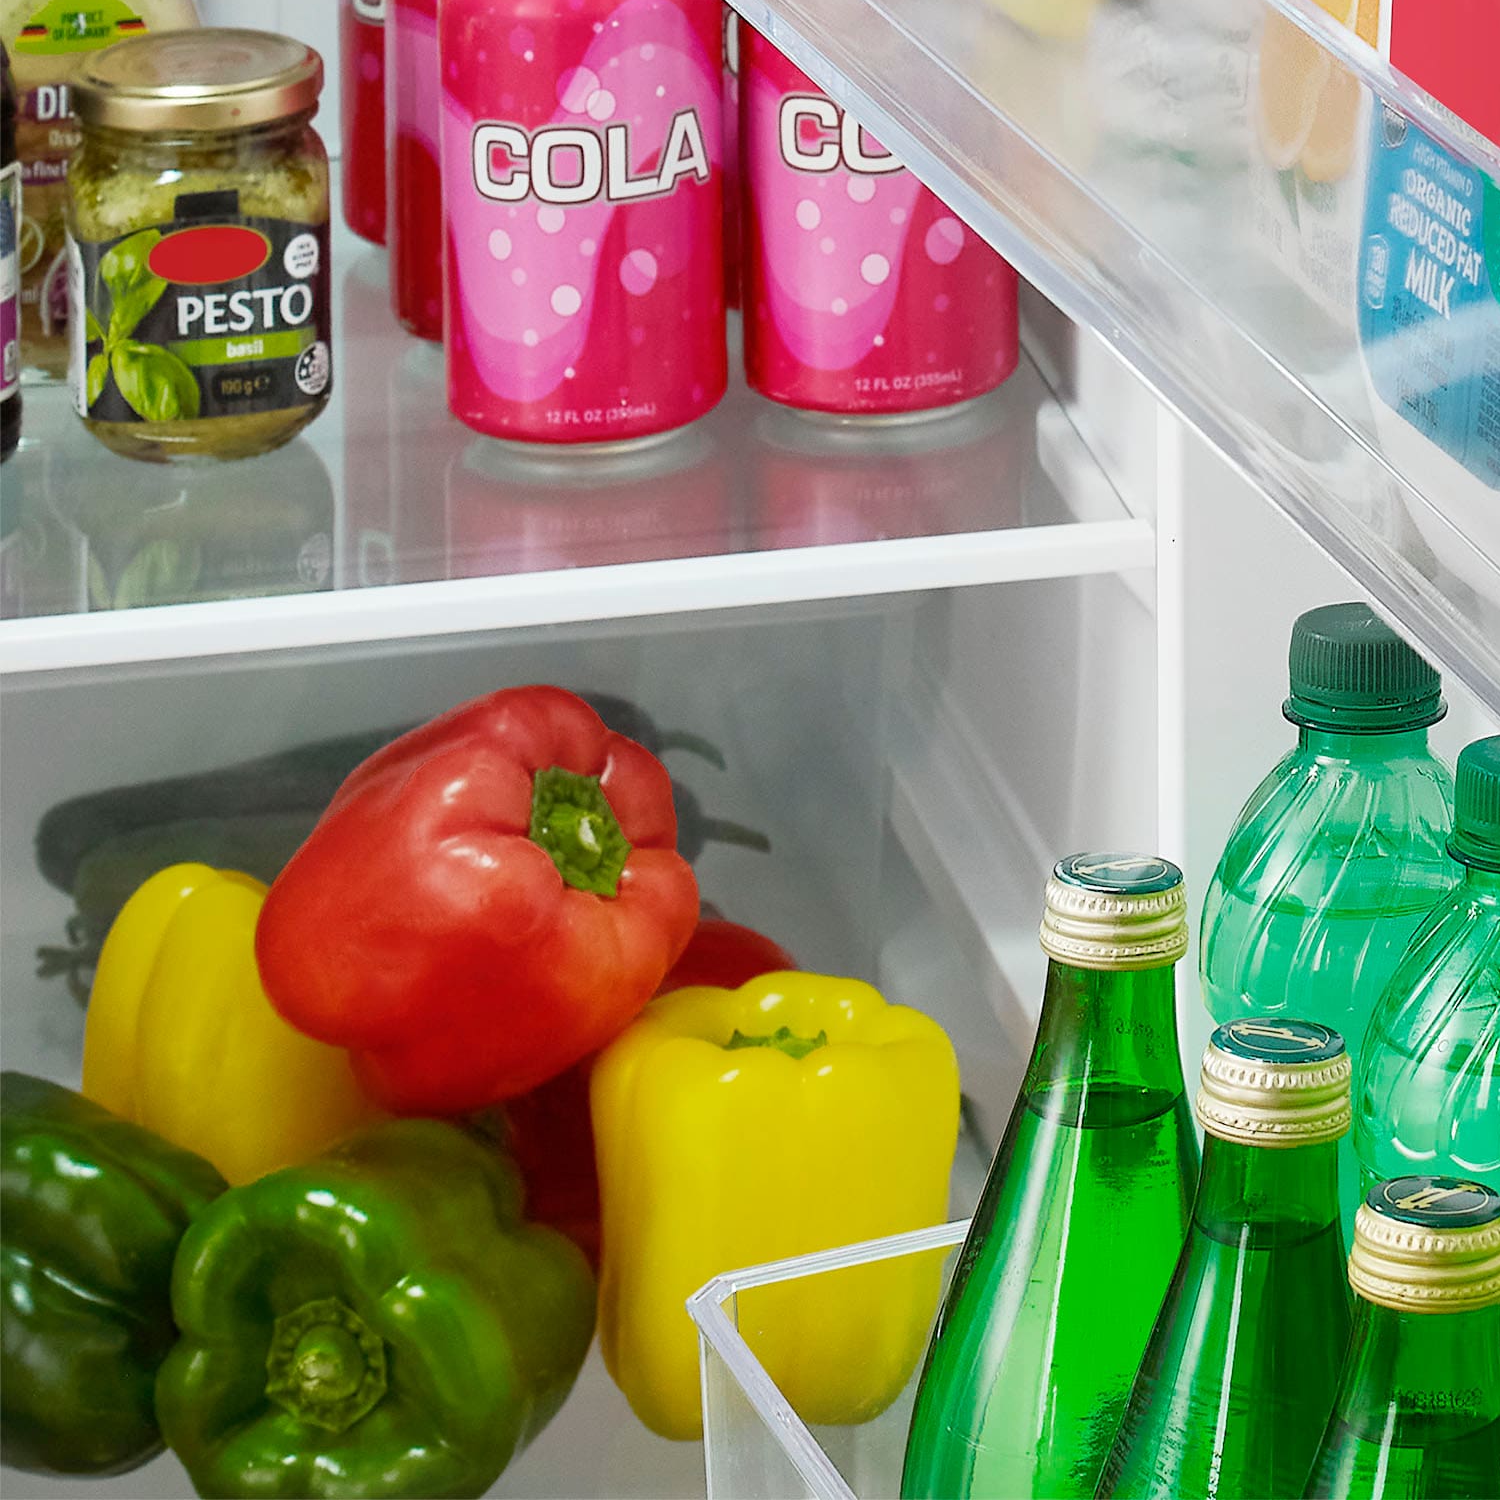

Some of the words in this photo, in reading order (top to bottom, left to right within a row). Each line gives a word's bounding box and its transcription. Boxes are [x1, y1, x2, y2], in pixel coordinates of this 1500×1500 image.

[472, 108, 710, 202] COLA
[1405, 168, 1471, 237] ORGANIC
[1387, 193, 1455, 266] REDUCED
[1456, 246, 1482, 286] FAT
[177, 284, 313, 336] PESTO
[1404, 245, 1455, 320] MILK
[226, 340, 264, 358] basil
[854, 377, 871, 392] 12
[873, 377, 890, 391] FL
[892, 376, 912, 390] OZ
[545, 411, 561, 424] 12
[563, 410, 580, 424] FL
[584, 409, 603, 423] OZ
